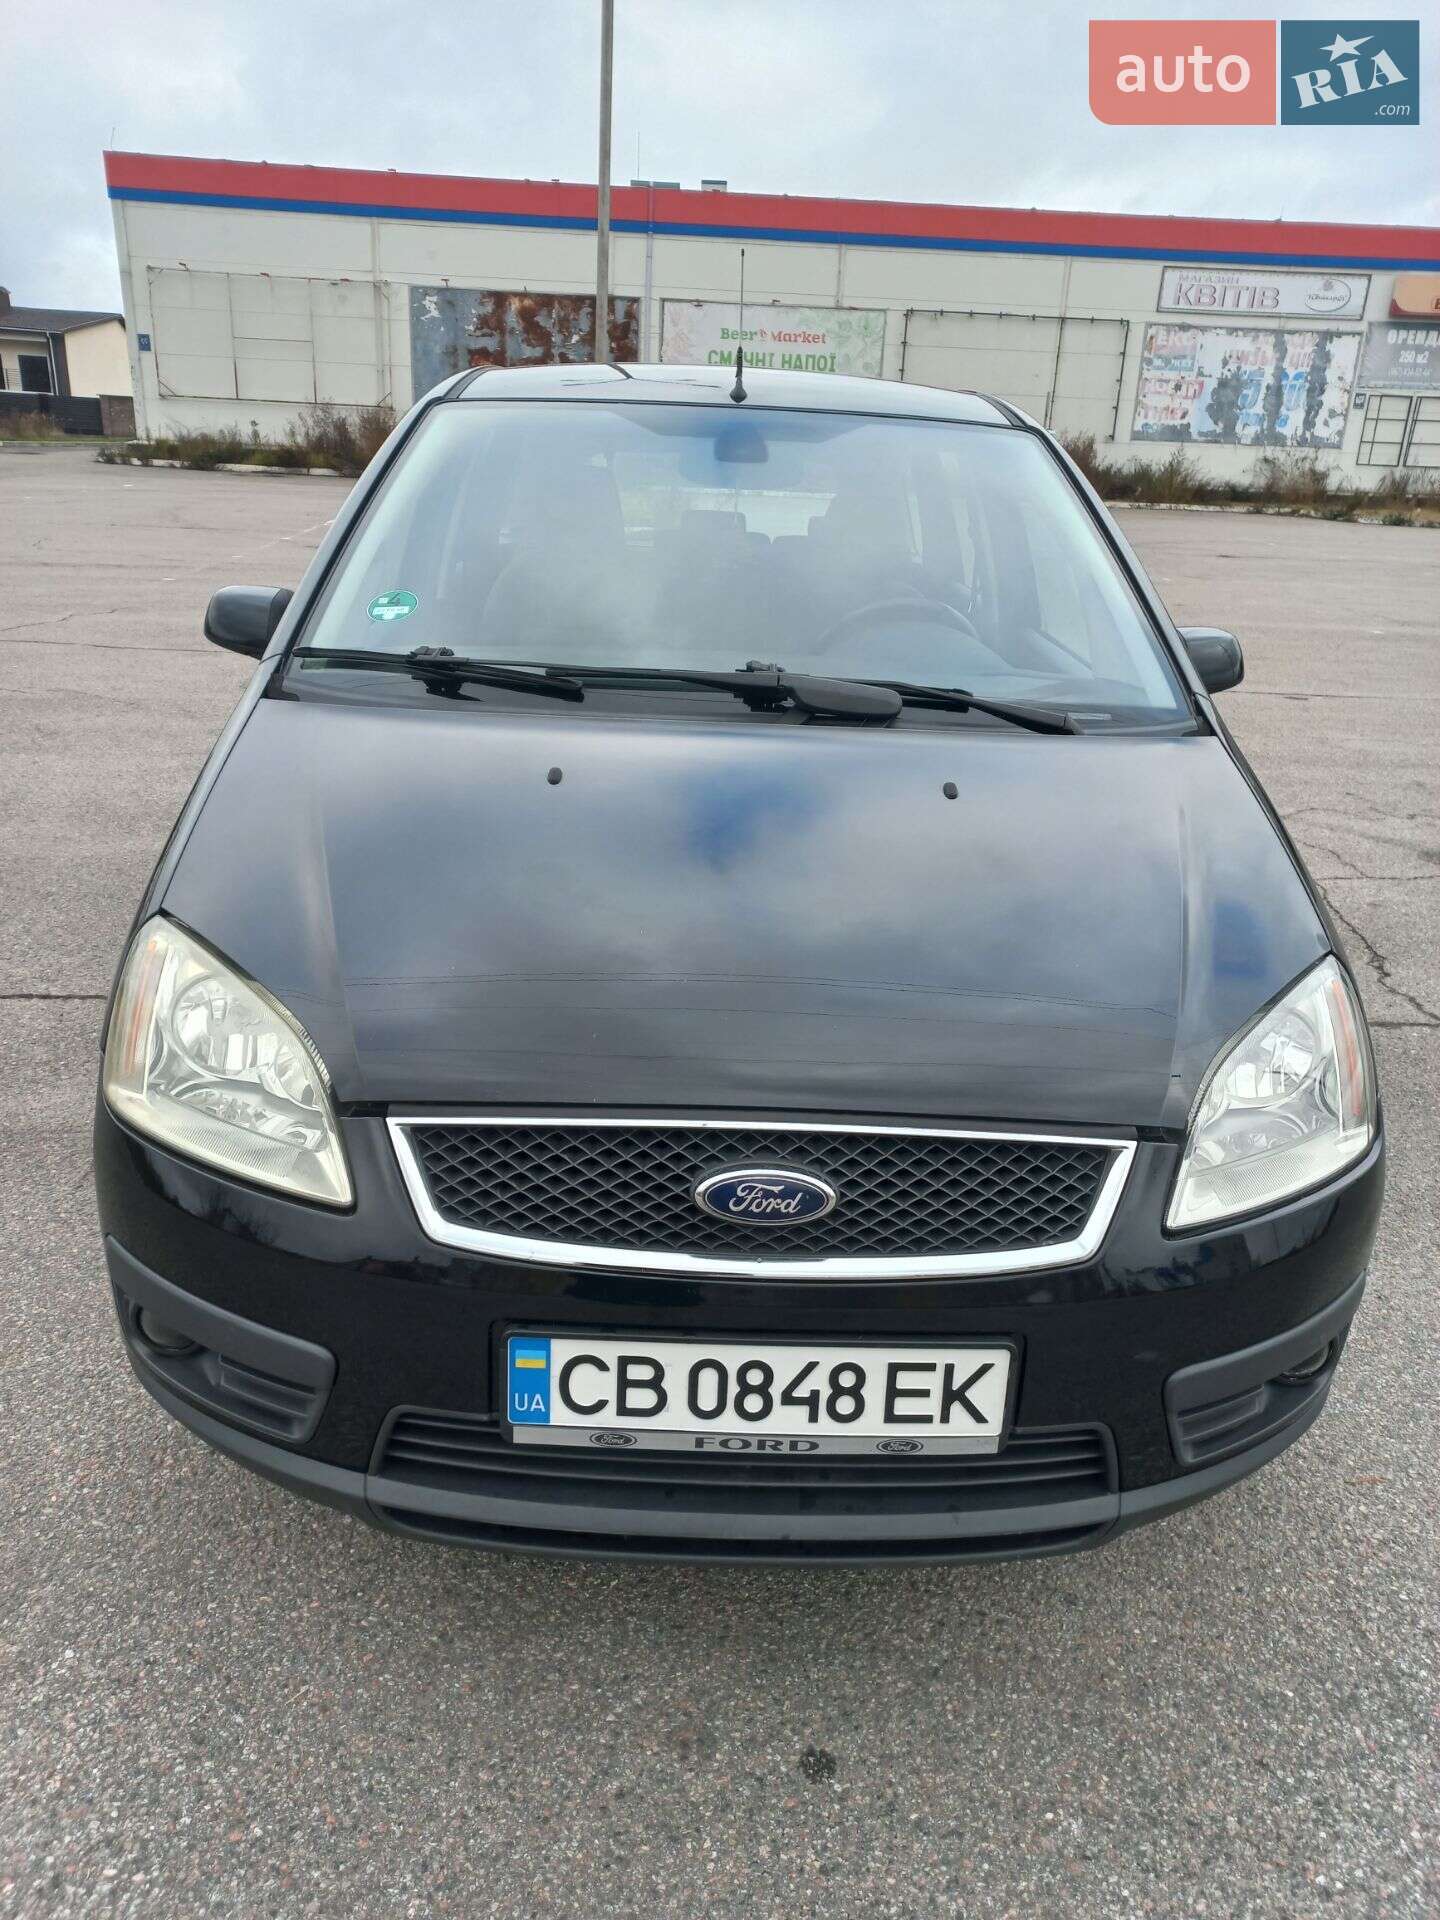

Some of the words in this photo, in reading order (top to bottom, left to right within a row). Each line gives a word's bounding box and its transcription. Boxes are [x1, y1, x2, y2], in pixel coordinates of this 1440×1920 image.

[1175, 283, 1279, 309] КВІТІВ
[720, 327, 757, 340] Beer
[771, 330, 826, 344] Market
[1387, 329, 1440, 347] ОРЕНД
[781, 351, 837, 373] НАПОЇ
[728, 1182, 804, 1213] Ford
[558, 1354, 668, 1417] CB
[687, 1358, 867, 1424] 0848
[883, 1361, 996, 1425] EK
[514, 1392, 545, 1413] UA
[694, 1437, 820, 1452] FORD
